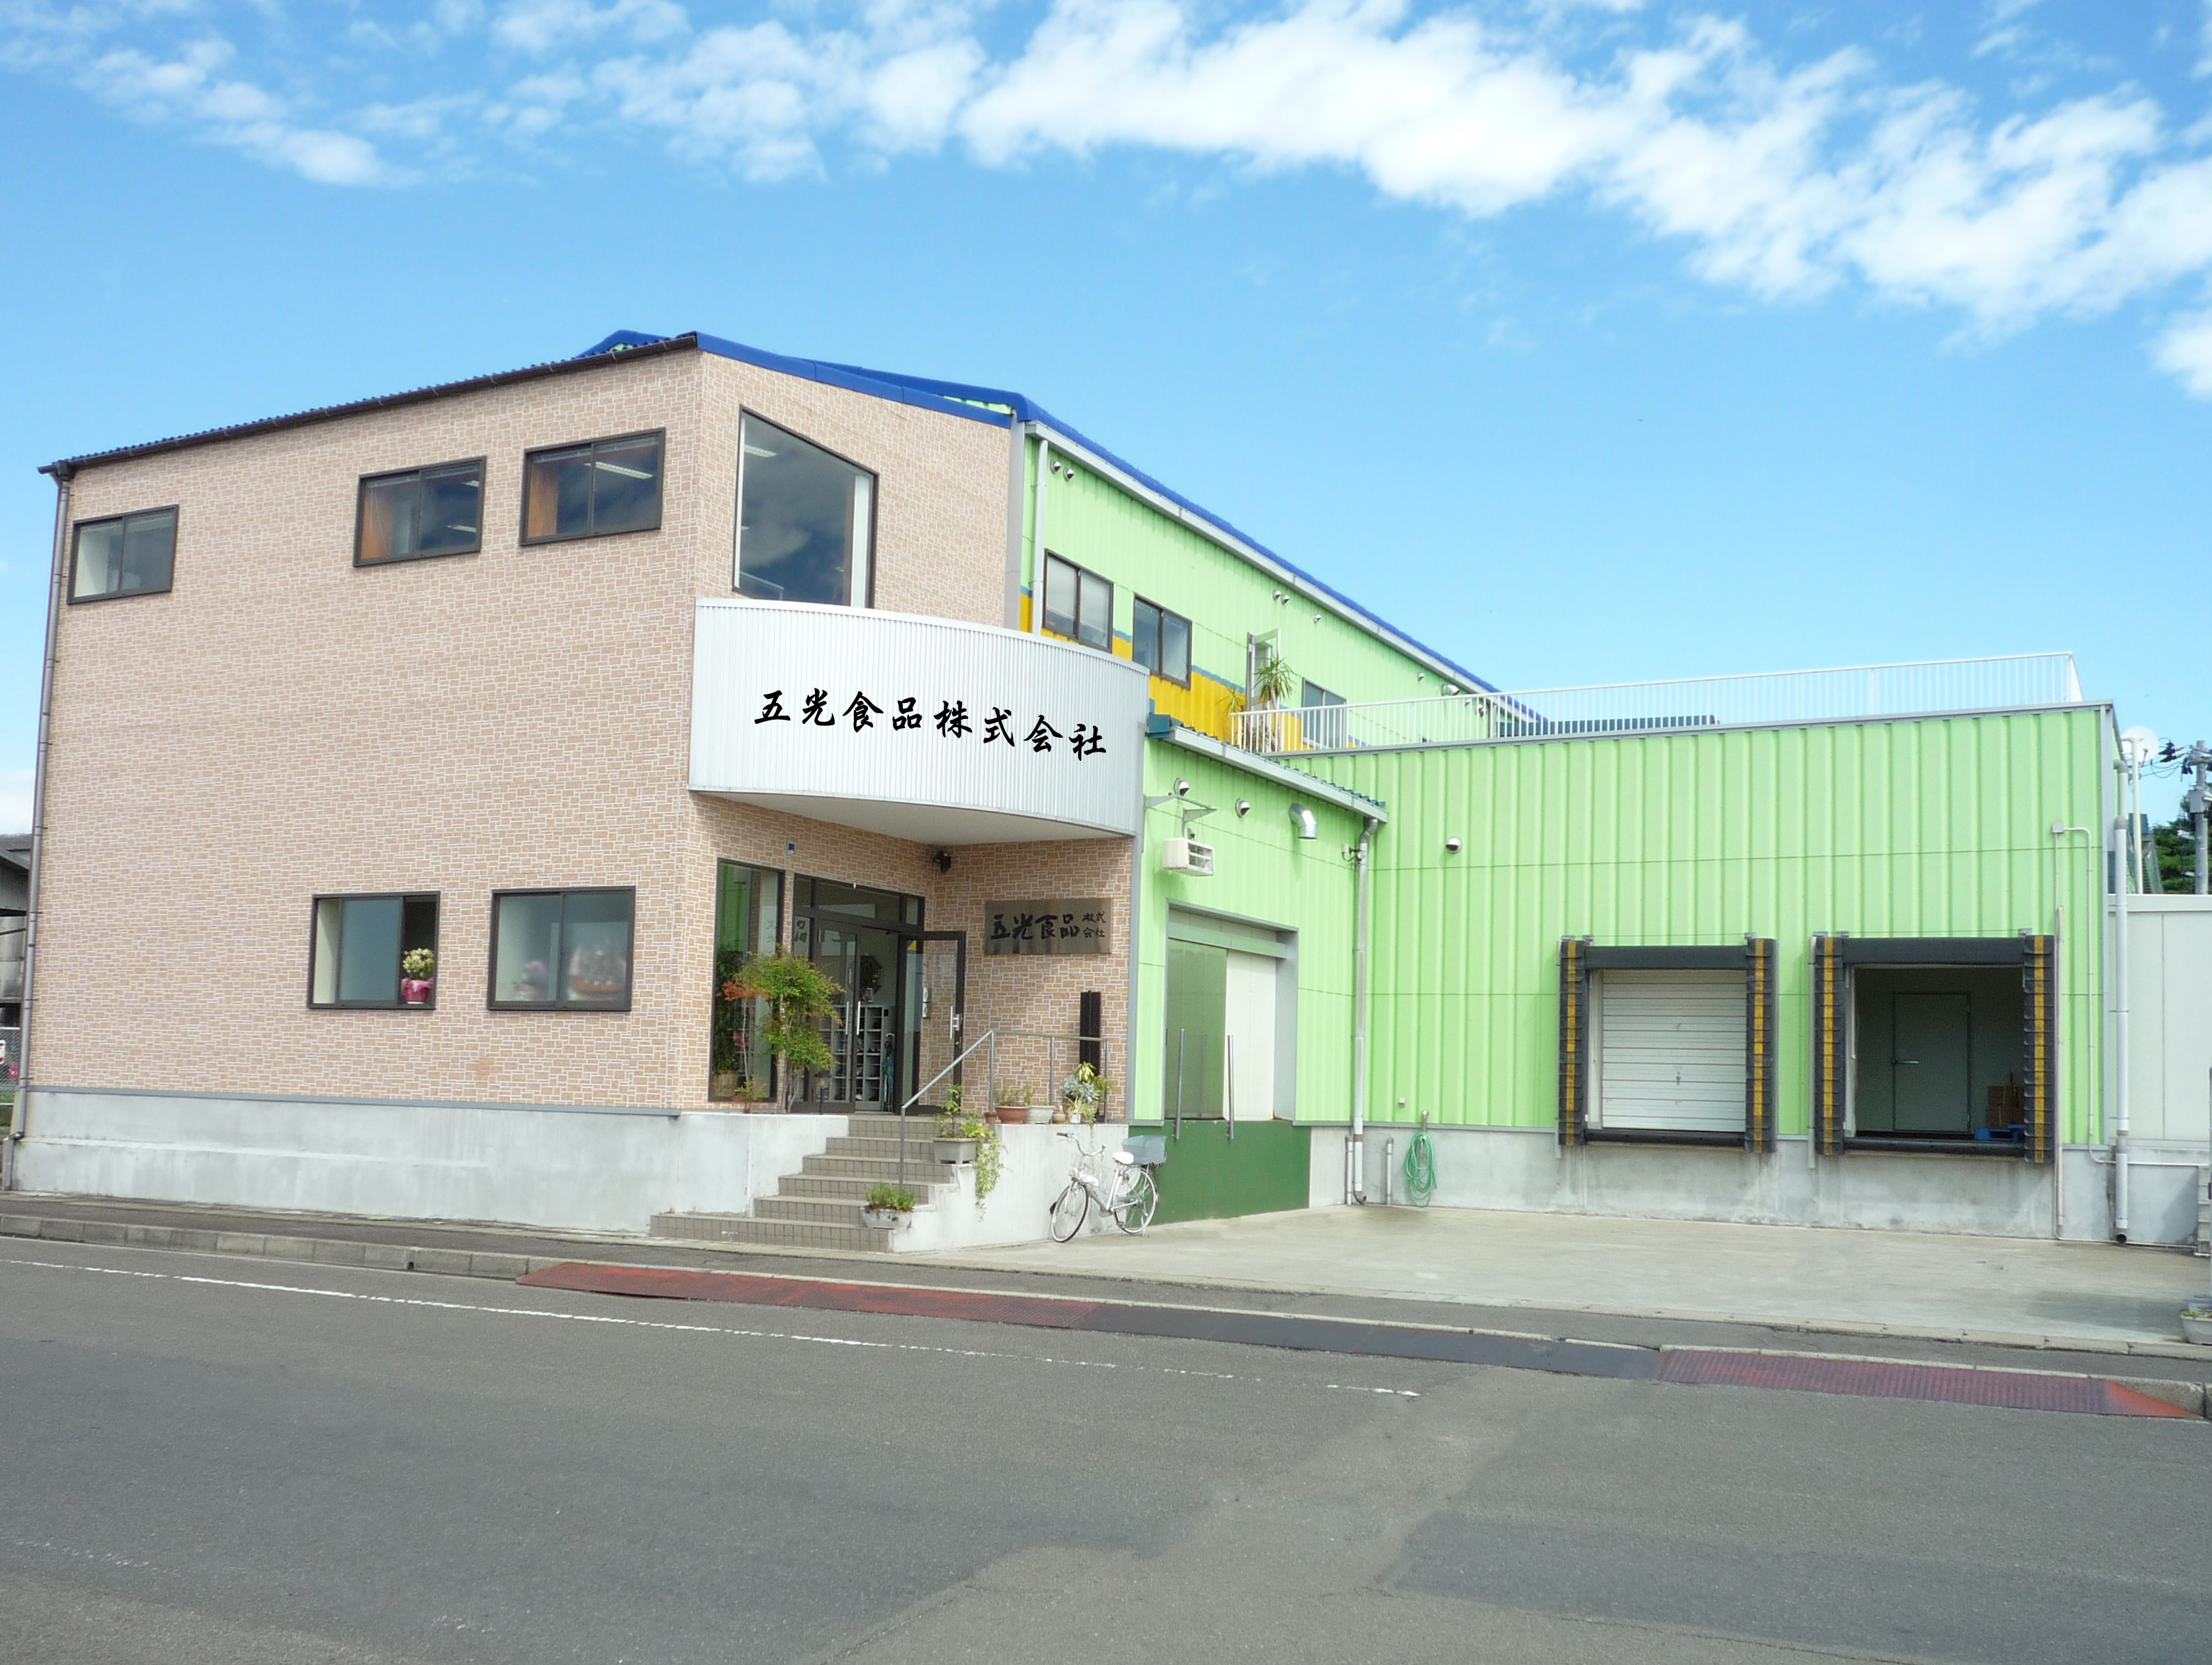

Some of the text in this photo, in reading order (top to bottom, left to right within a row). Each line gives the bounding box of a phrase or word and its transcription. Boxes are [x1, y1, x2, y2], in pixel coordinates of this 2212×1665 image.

[754, 688, 1107, 761] 五光食品株式会社
[990, 913, 1080, 940] 五光食品
[1082, 927, 1105, 938] 会社
